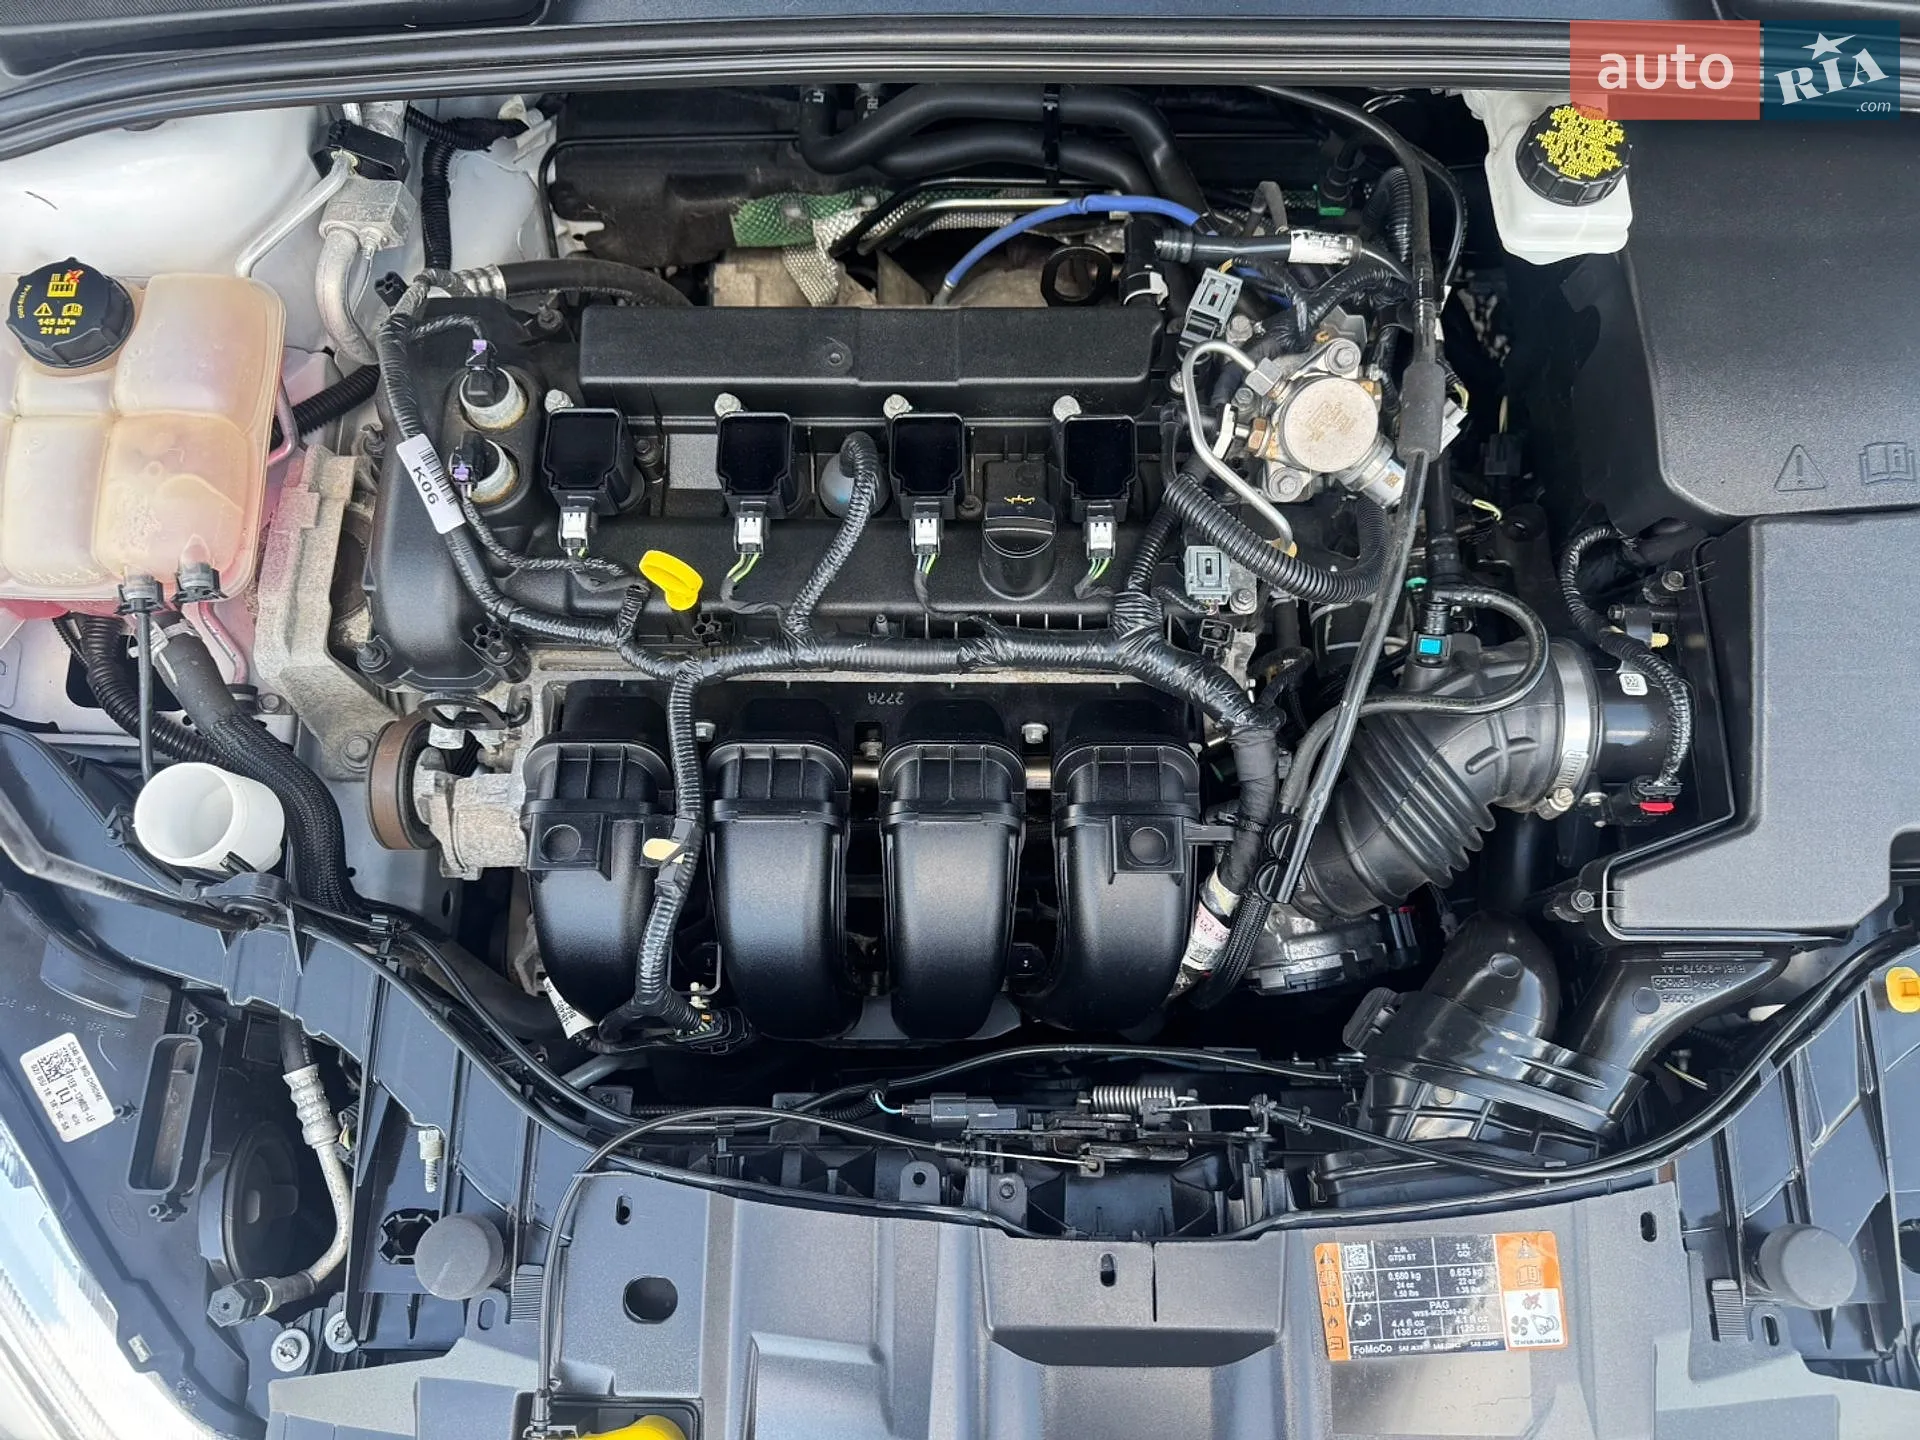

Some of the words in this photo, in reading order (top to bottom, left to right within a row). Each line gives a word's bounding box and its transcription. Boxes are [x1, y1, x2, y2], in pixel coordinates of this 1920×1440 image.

[37, 318, 56, 326] 145
[57, 318, 76, 326] kPa
[40, 327, 53, 335] 21
[54, 327, 71, 336] psi
[413, 467, 439, 505] K06
[1410, 1271, 1421, 1281] kg
[1429, 1300, 1450, 1310] PAG
[1413, 1319, 1425, 1327] oz
[1413, 1327, 1427, 1337] cc)
[1352, 1343, 1393, 1354] FoMoCo
